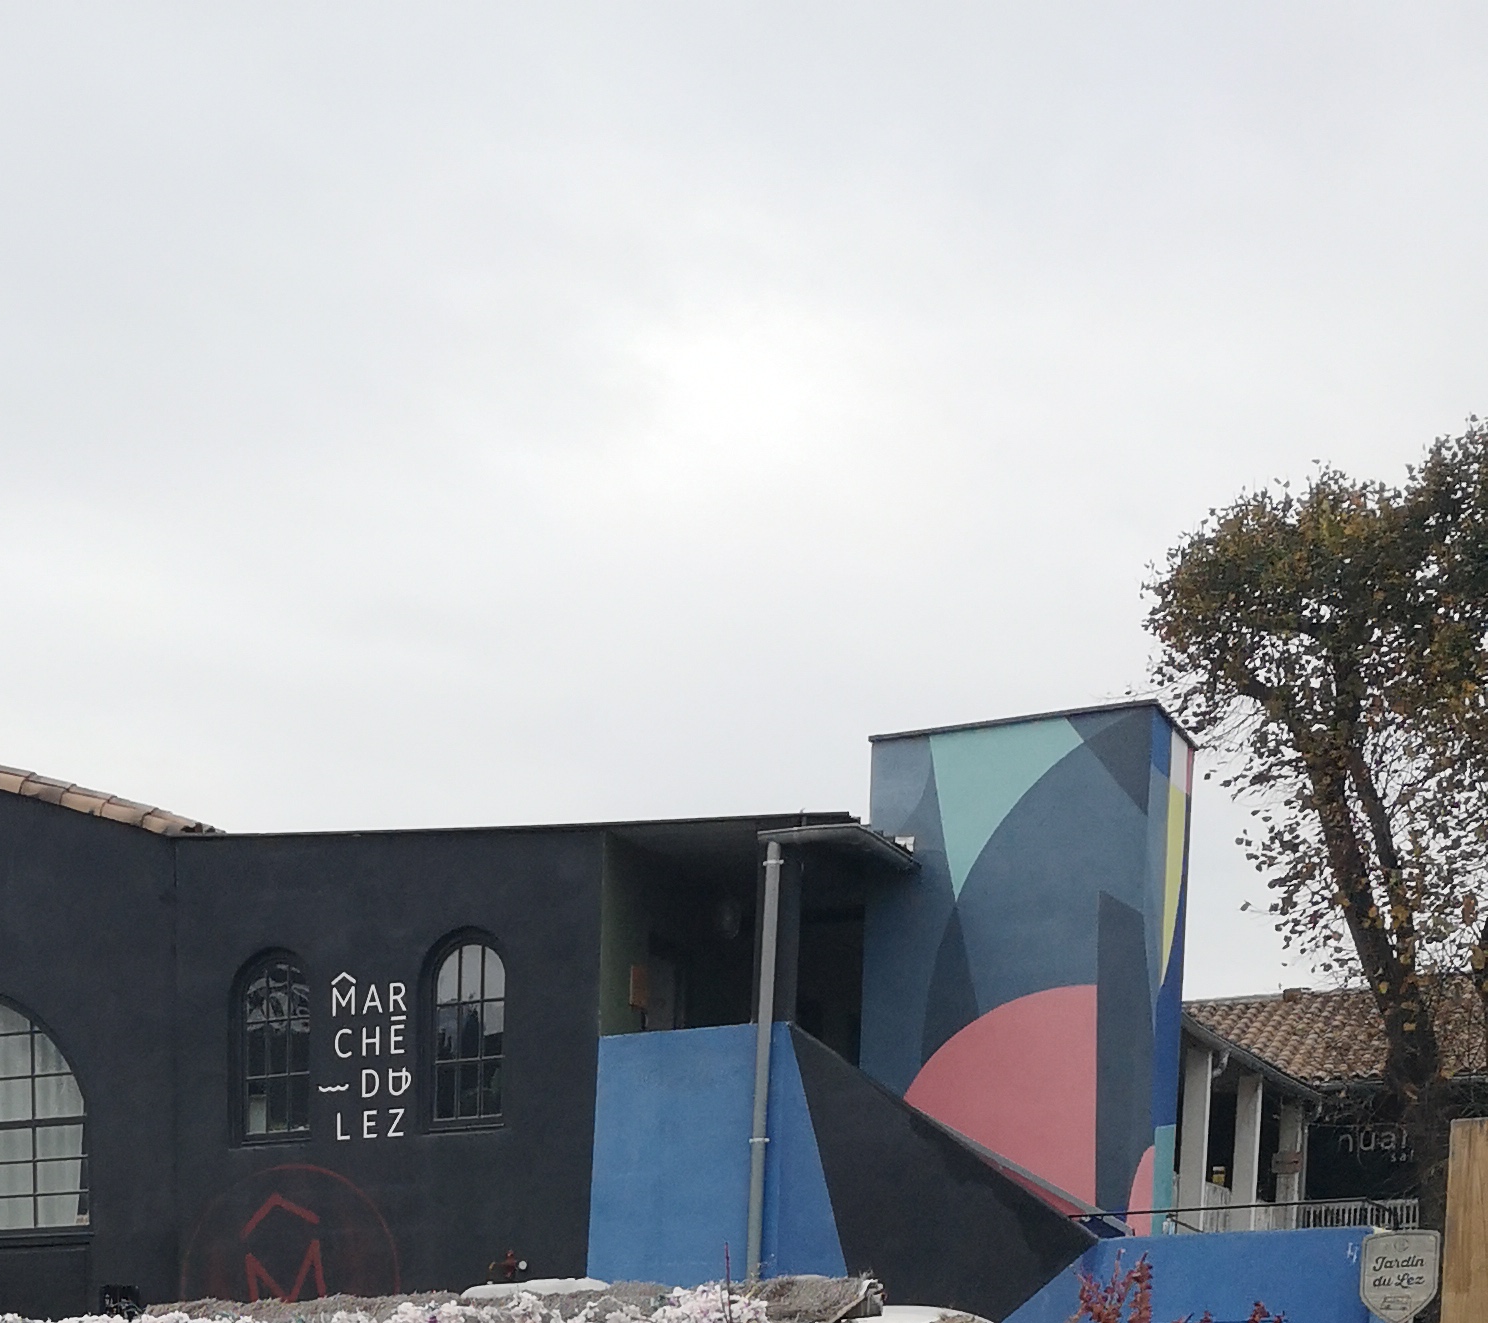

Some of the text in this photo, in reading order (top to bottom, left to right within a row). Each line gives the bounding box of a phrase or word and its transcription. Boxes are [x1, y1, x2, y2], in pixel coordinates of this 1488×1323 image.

[361, 1066, 412, 1098] DU
[336, 1108, 407, 1141] LEZ
[1373, 1255, 1425, 1272] Jardin
[1373, 1273, 1425, 1289] du Lez
